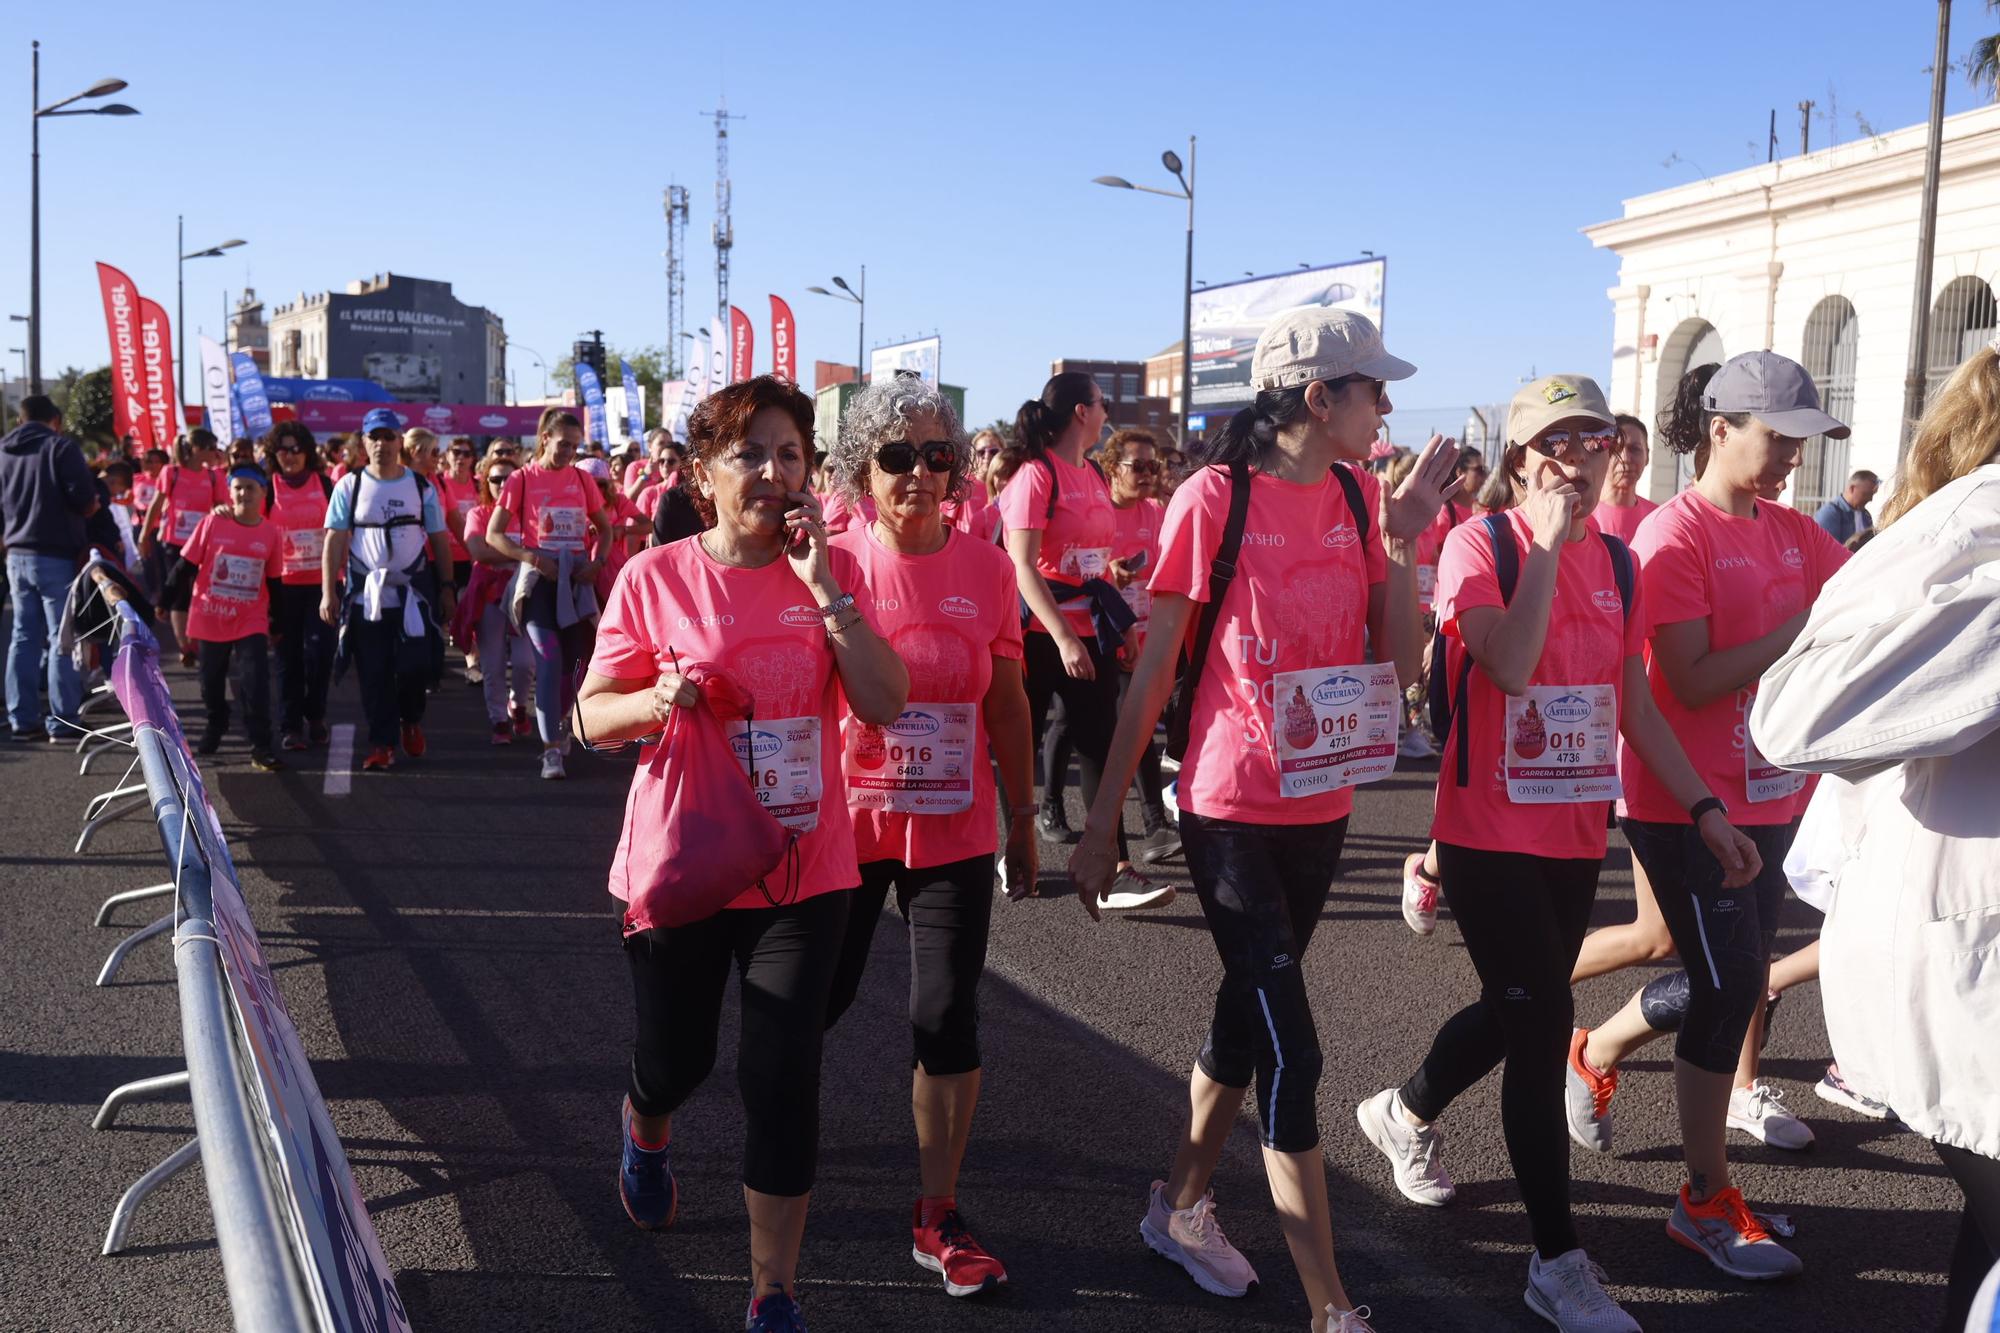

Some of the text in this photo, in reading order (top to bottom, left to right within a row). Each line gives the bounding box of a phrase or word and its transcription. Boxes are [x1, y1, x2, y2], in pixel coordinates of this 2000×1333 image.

[354, 309, 394, 322] PUERTO
[679, 614, 734, 630] OYSHO
[1237, 635, 1277, 666] TU
[889, 721, 936, 731] ASTURIANA
[1321, 713, 1358, 735] 016
[1330, 736, 1351, 749] 4731
[1550, 732, 1585, 748] 016
[890, 745, 932, 762] 016
[1295, 759, 1328, 769] CARRERA
[1339, 753, 1346, 761] LA
[1346, 750, 1367, 759] MUJER
[1557, 752, 1580, 763] 4736
[897, 766, 924, 776] 6403
[1351, 764, 1387, 776] Santander
[1520, 769, 1554, 777] CARRERA
[1576, 768, 1595, 776] MUJER
[754, 769, 778, 787] 16
[861, 779, 895, 788] CARRERA
[908, 781, 917, 789] LA
[1293, 775, 1327, 788] OYSHO
[1518, 785, 1554, 795] OYSHO
[1581, 783, 1612, 793] Santander
[857, 794, 895, 804] OYSHO
[925, 796, 962, 806] Santander
